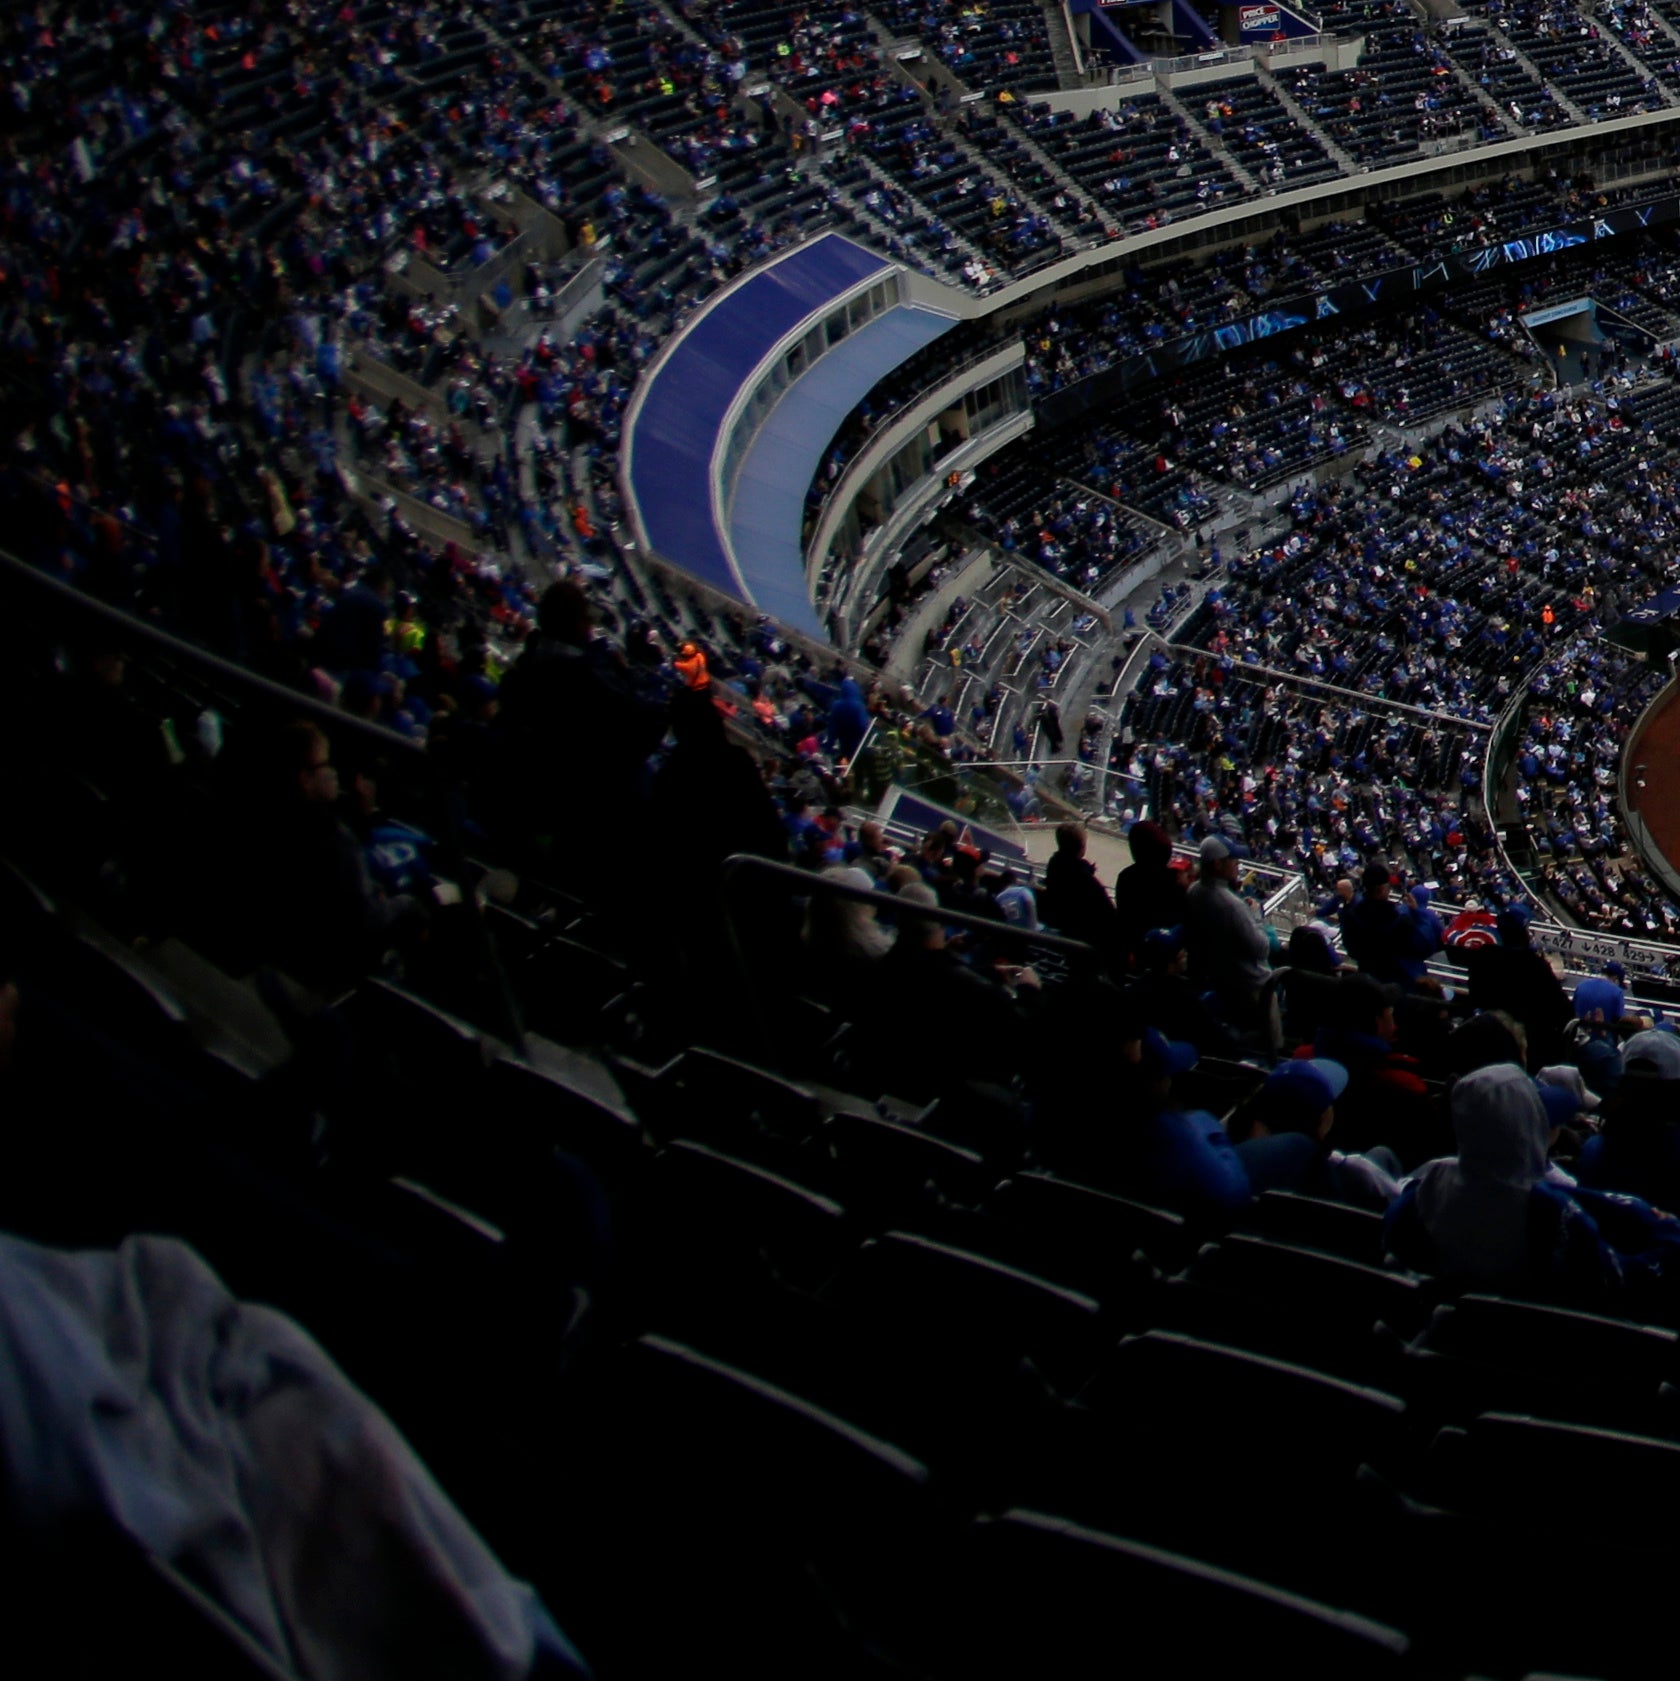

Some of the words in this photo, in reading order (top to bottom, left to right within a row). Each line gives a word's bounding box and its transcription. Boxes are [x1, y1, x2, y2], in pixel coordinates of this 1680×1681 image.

[1242, 7, 1264, 19] PRICE
[1242, 14, 1279, 29] CHOPPER
[1552, 936, 1573, 949] 427
[1593, 943, 1615, 957] 428
[1623, 948, 1645, 962] 429
